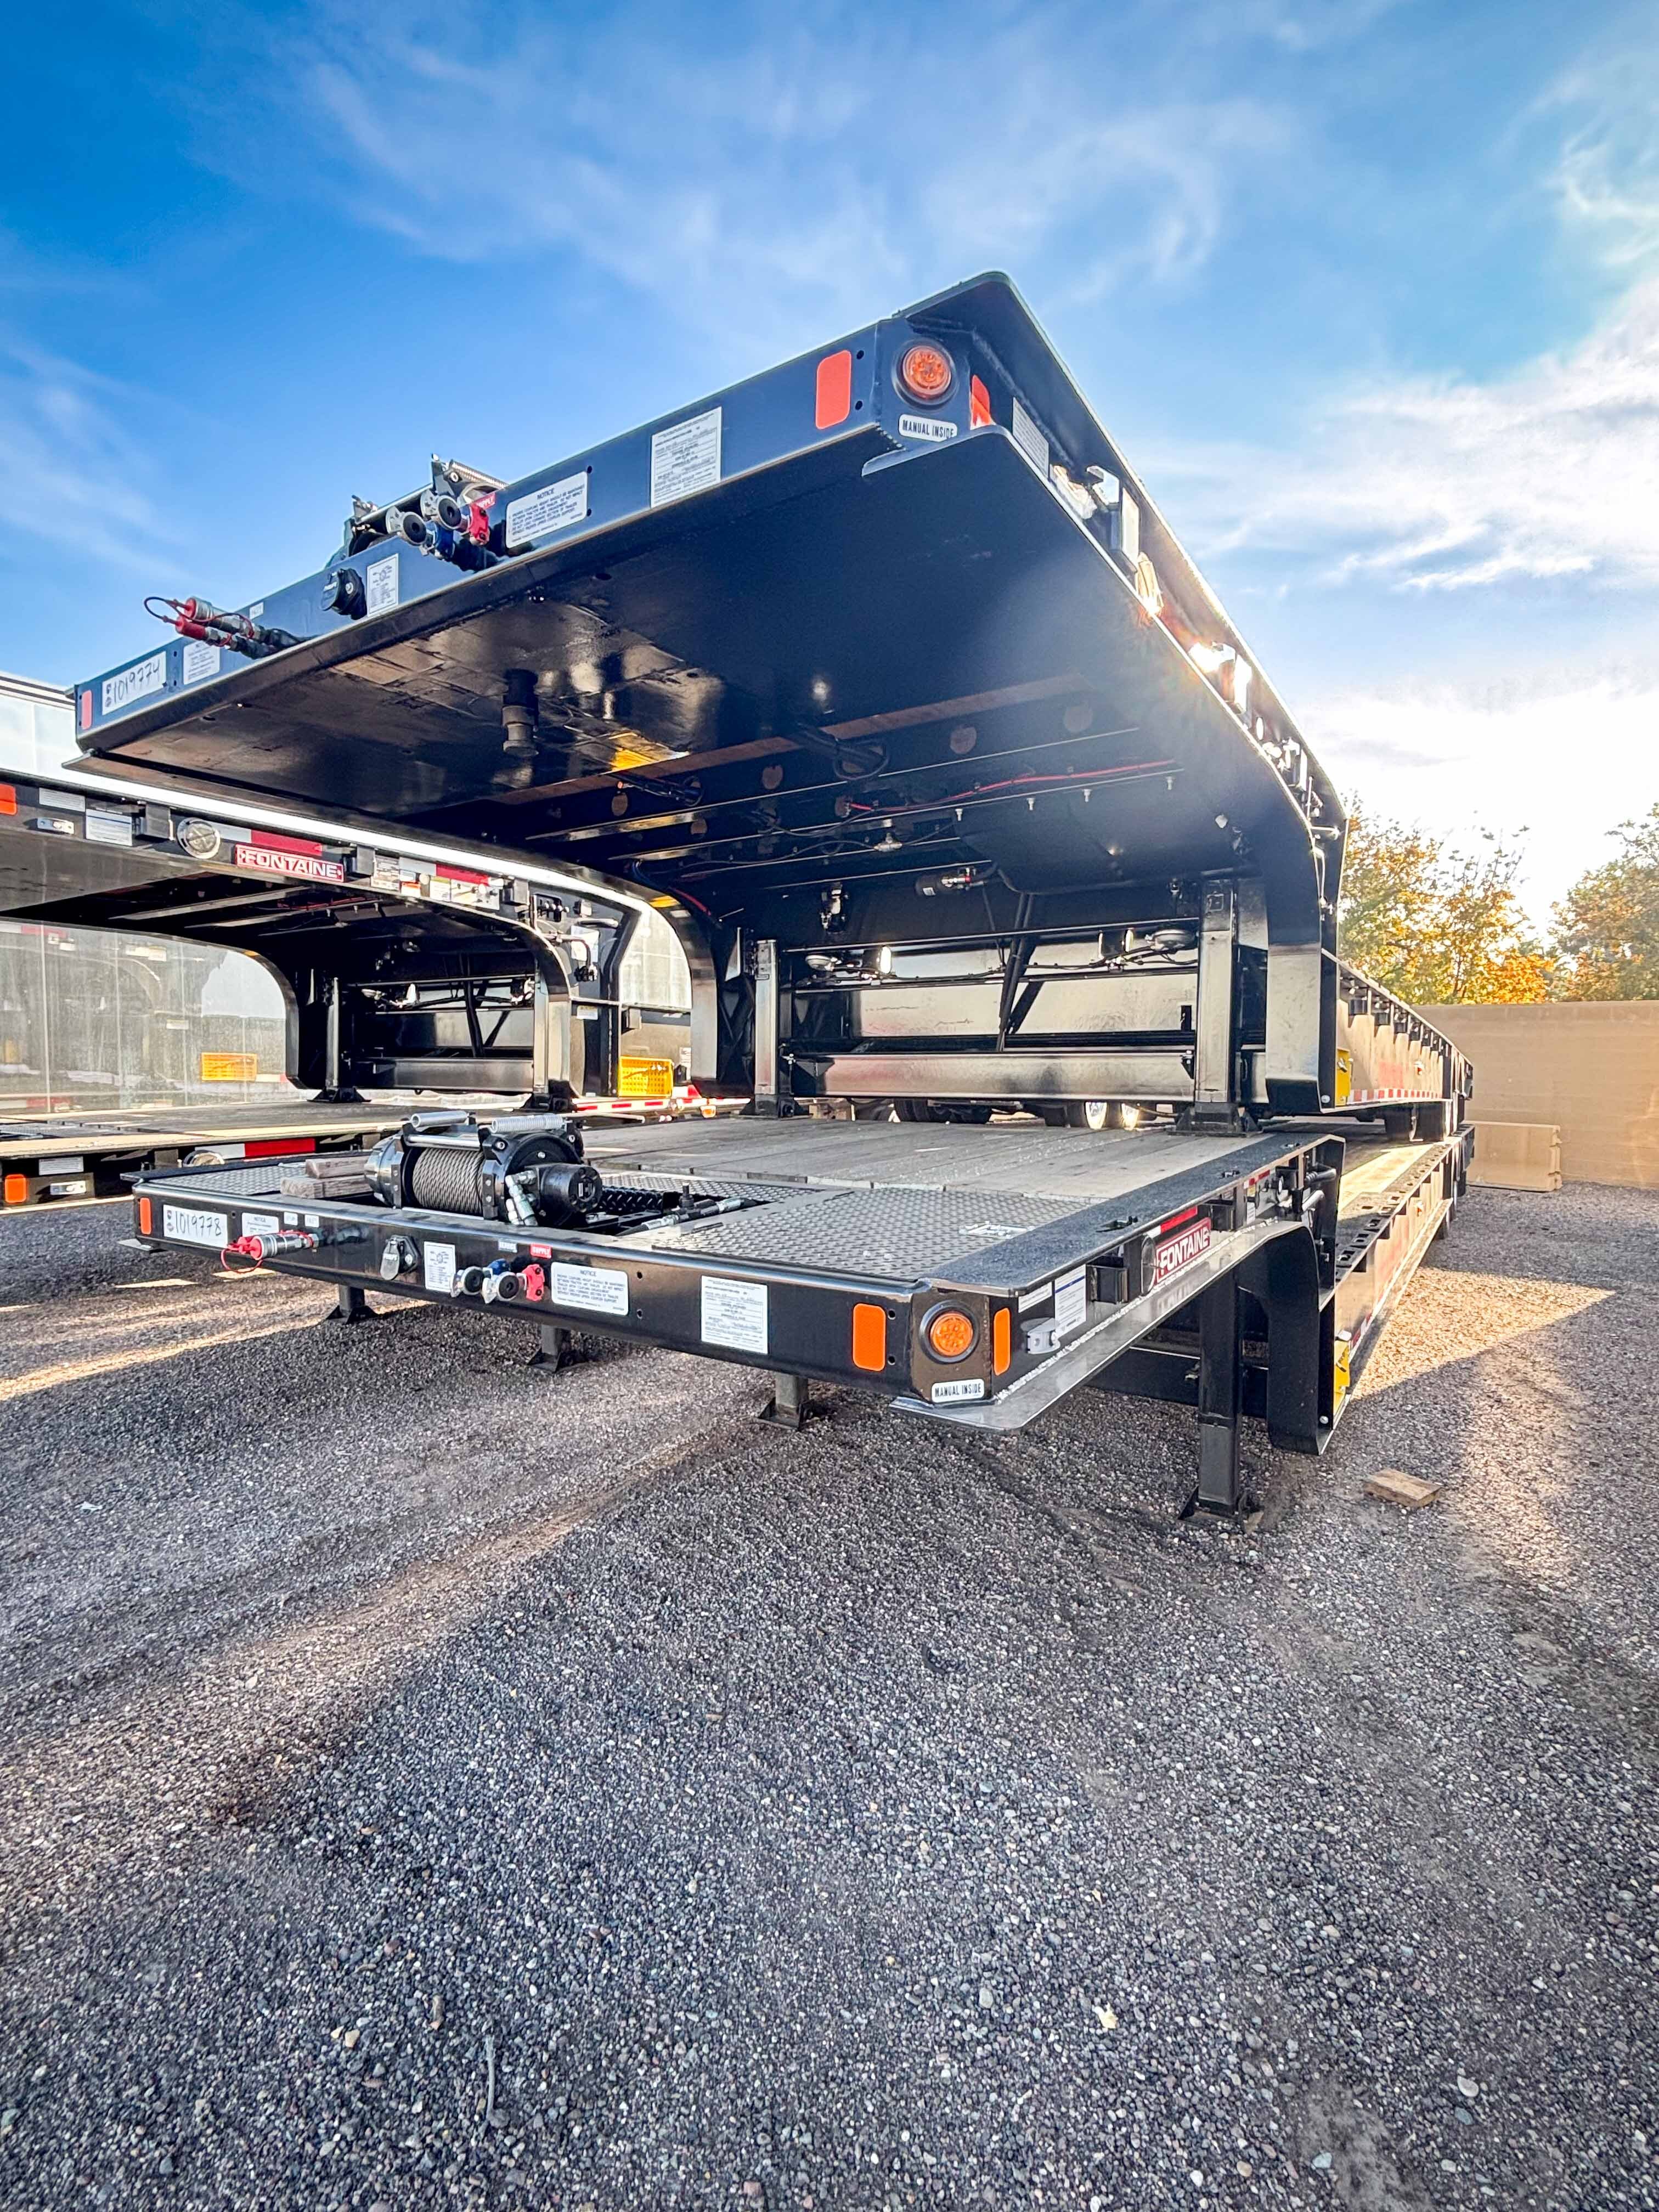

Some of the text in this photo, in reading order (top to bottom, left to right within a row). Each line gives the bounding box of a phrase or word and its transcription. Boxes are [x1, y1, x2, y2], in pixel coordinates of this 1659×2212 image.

[902, 420, 954, 439] MANUAL INSIDE
[537, 488, 555, 500] NOTICE
[245, 850, 337, 878] FONTAINE
[176, 1211, 222, 1238] 1019778
[1160, 1226, 1209, 1275] FONTAINE
[935, 1383, 981, 1397] MANUAL INSIDE
